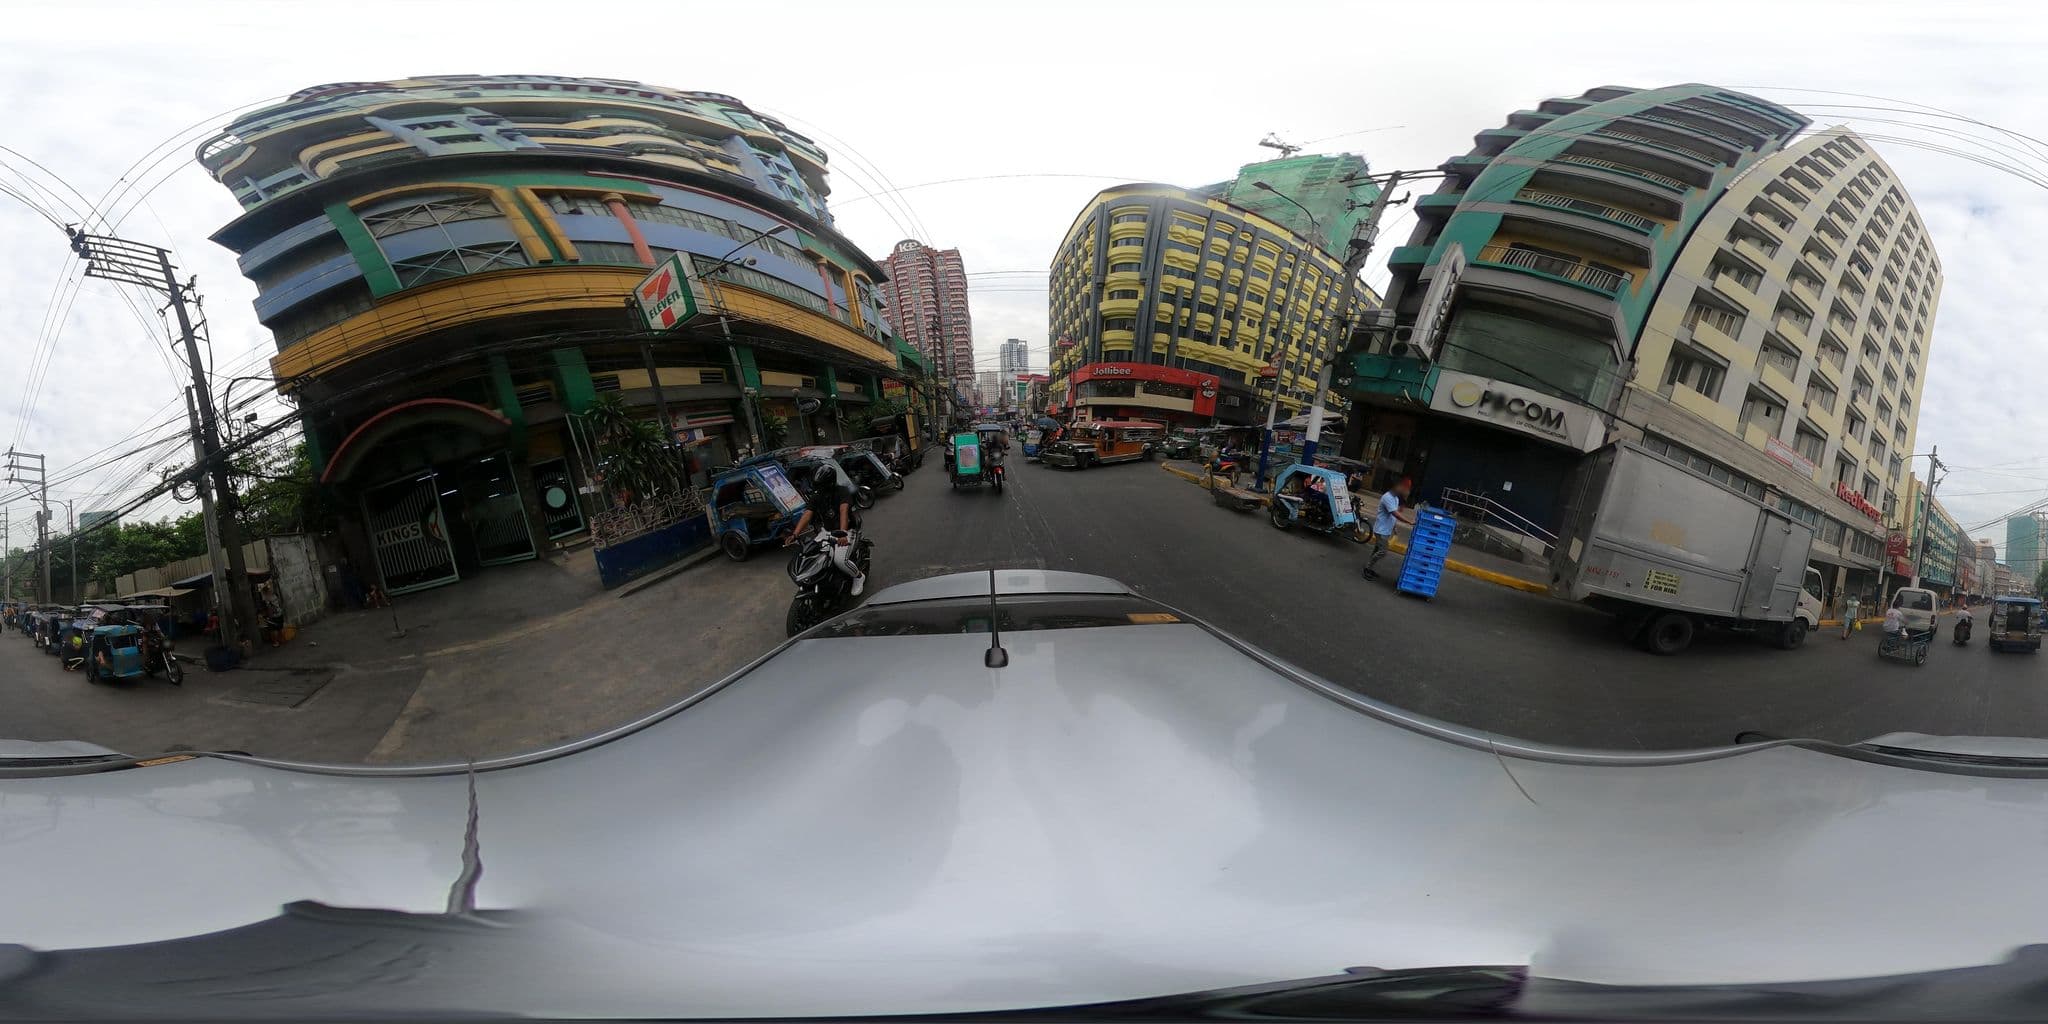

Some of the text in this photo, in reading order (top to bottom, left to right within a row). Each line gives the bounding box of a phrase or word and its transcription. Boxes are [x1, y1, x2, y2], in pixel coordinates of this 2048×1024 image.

[642, 268, 677, 329] 7
[1093, 365, 1132, 376] Jollibee
[376, 523, 420, 546] KINGS
